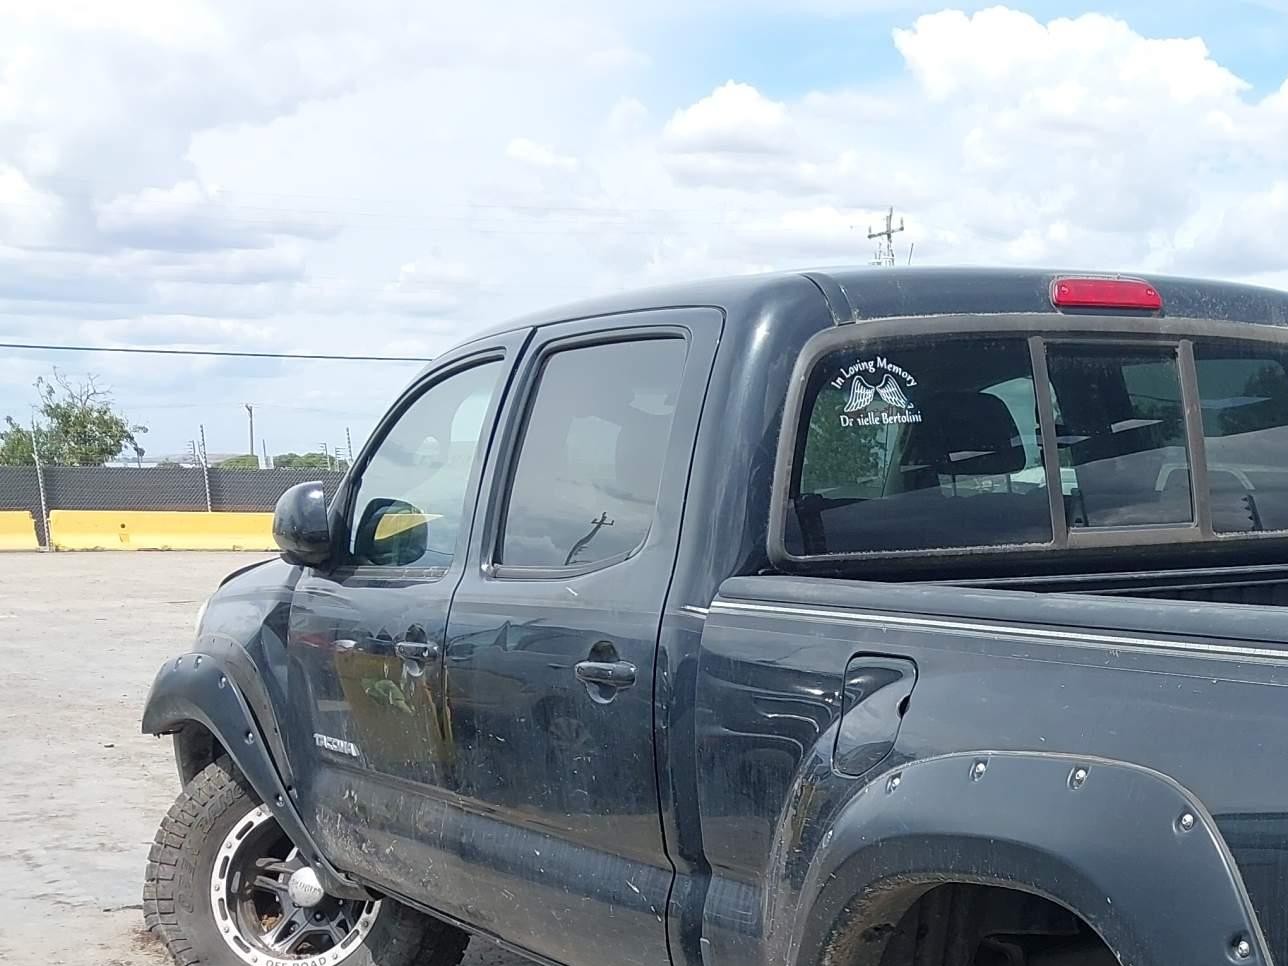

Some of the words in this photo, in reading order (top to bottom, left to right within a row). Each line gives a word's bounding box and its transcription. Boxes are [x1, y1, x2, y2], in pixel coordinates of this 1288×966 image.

[831, 378, 845, 390] In
[840, 359, 876, 379] Loving
[876, 356, 918, 387] Memory
[881, 410, 922, 424] Bertolini
